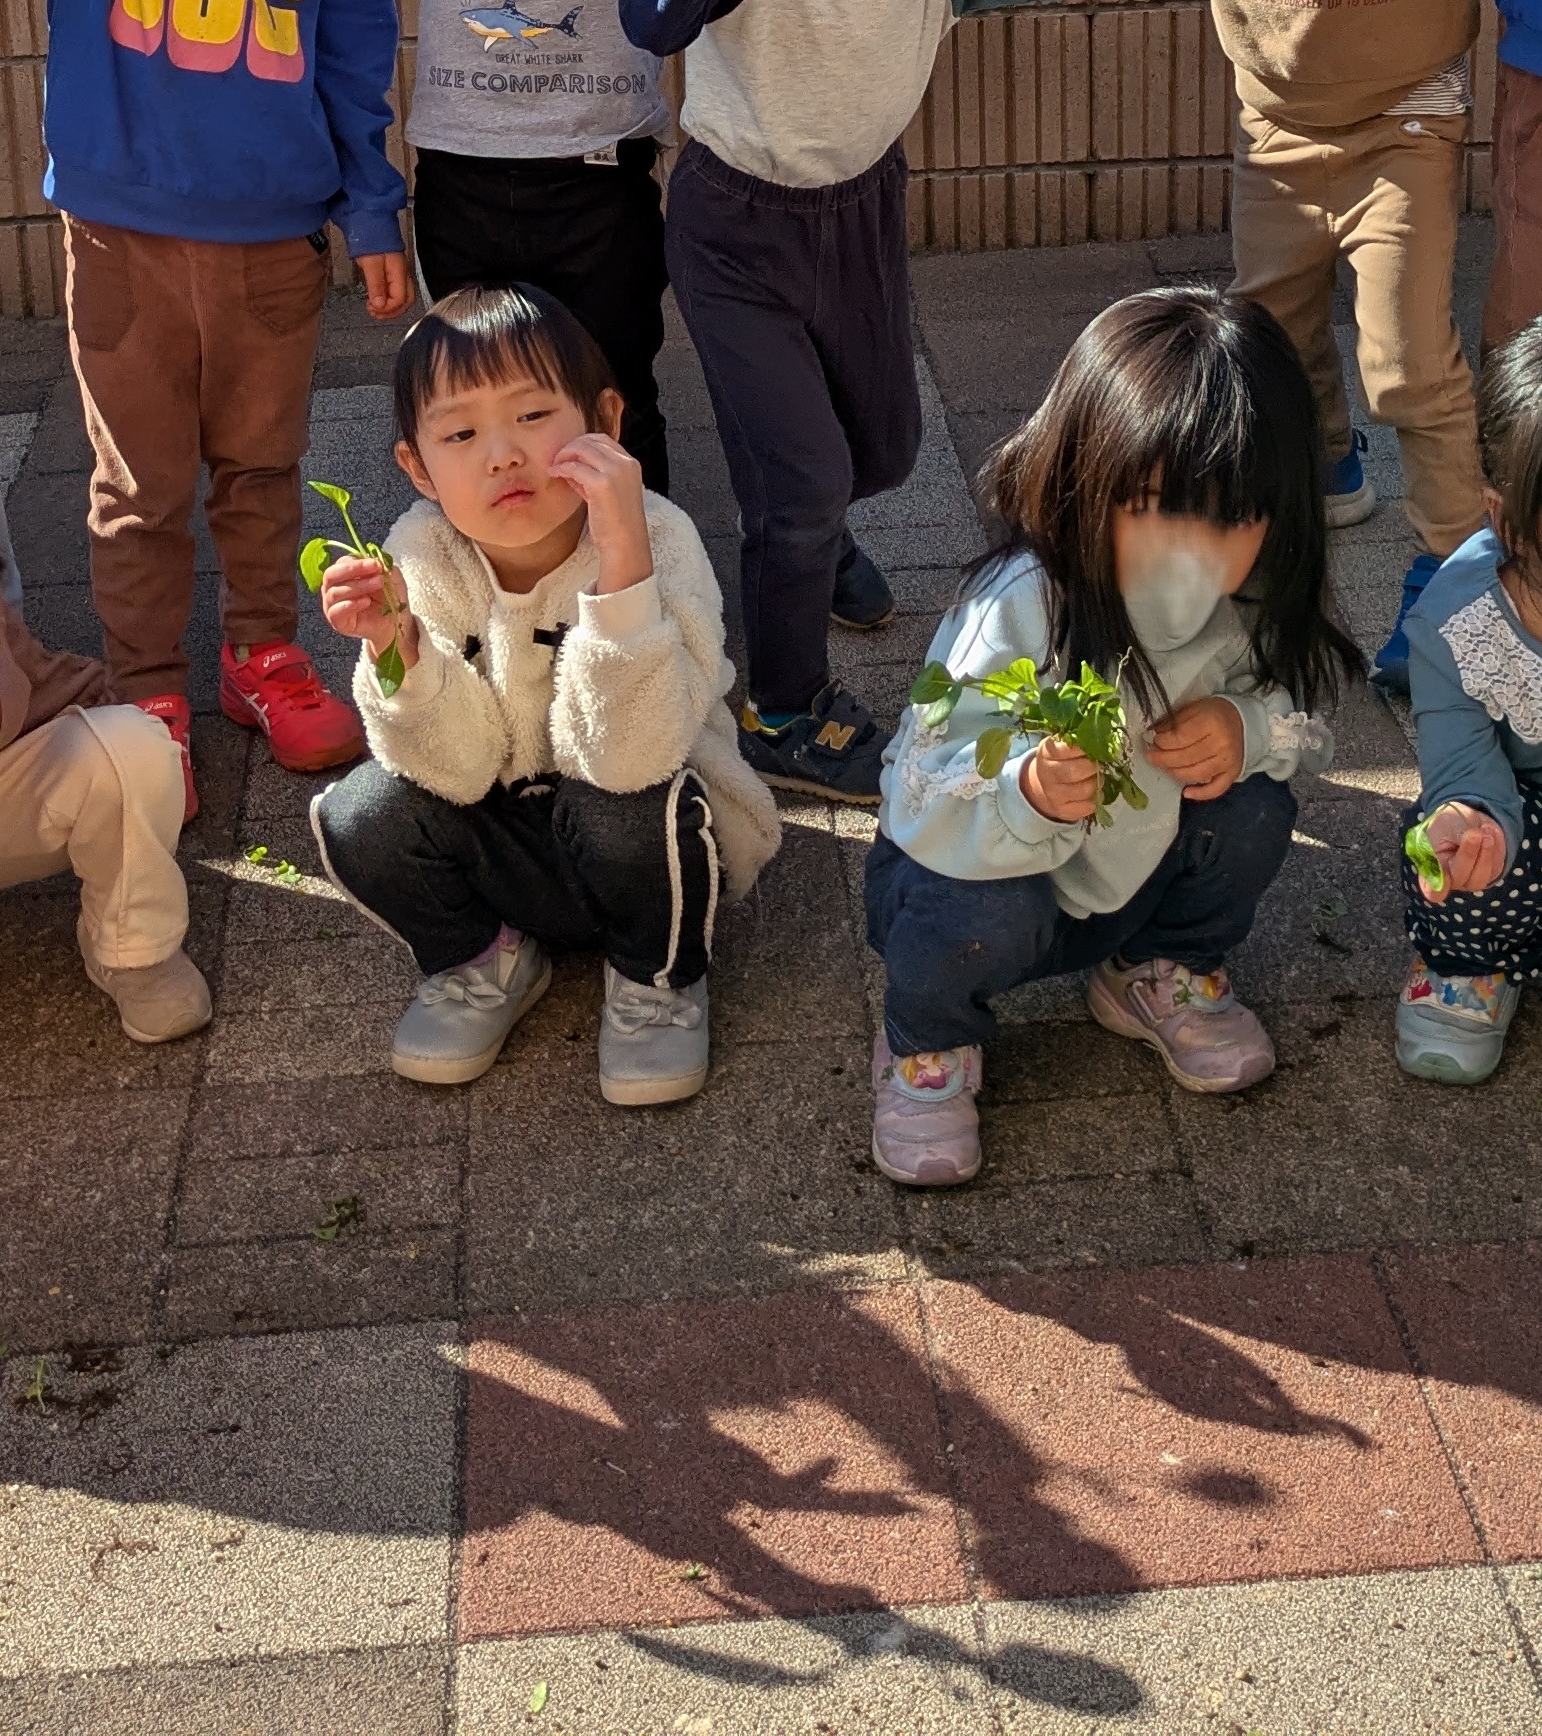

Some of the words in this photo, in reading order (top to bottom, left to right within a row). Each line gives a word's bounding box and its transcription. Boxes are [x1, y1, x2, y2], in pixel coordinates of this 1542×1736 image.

[495, 53, 520, 64] GREAT
[524, 53, 551, 65] WHITE
[555, 52, 583, 64] SHARK
[429, 66, 465, 88] SIZE
[471, 72, 646, 94] COMPARISON
[814, 720, 856, 751] N
